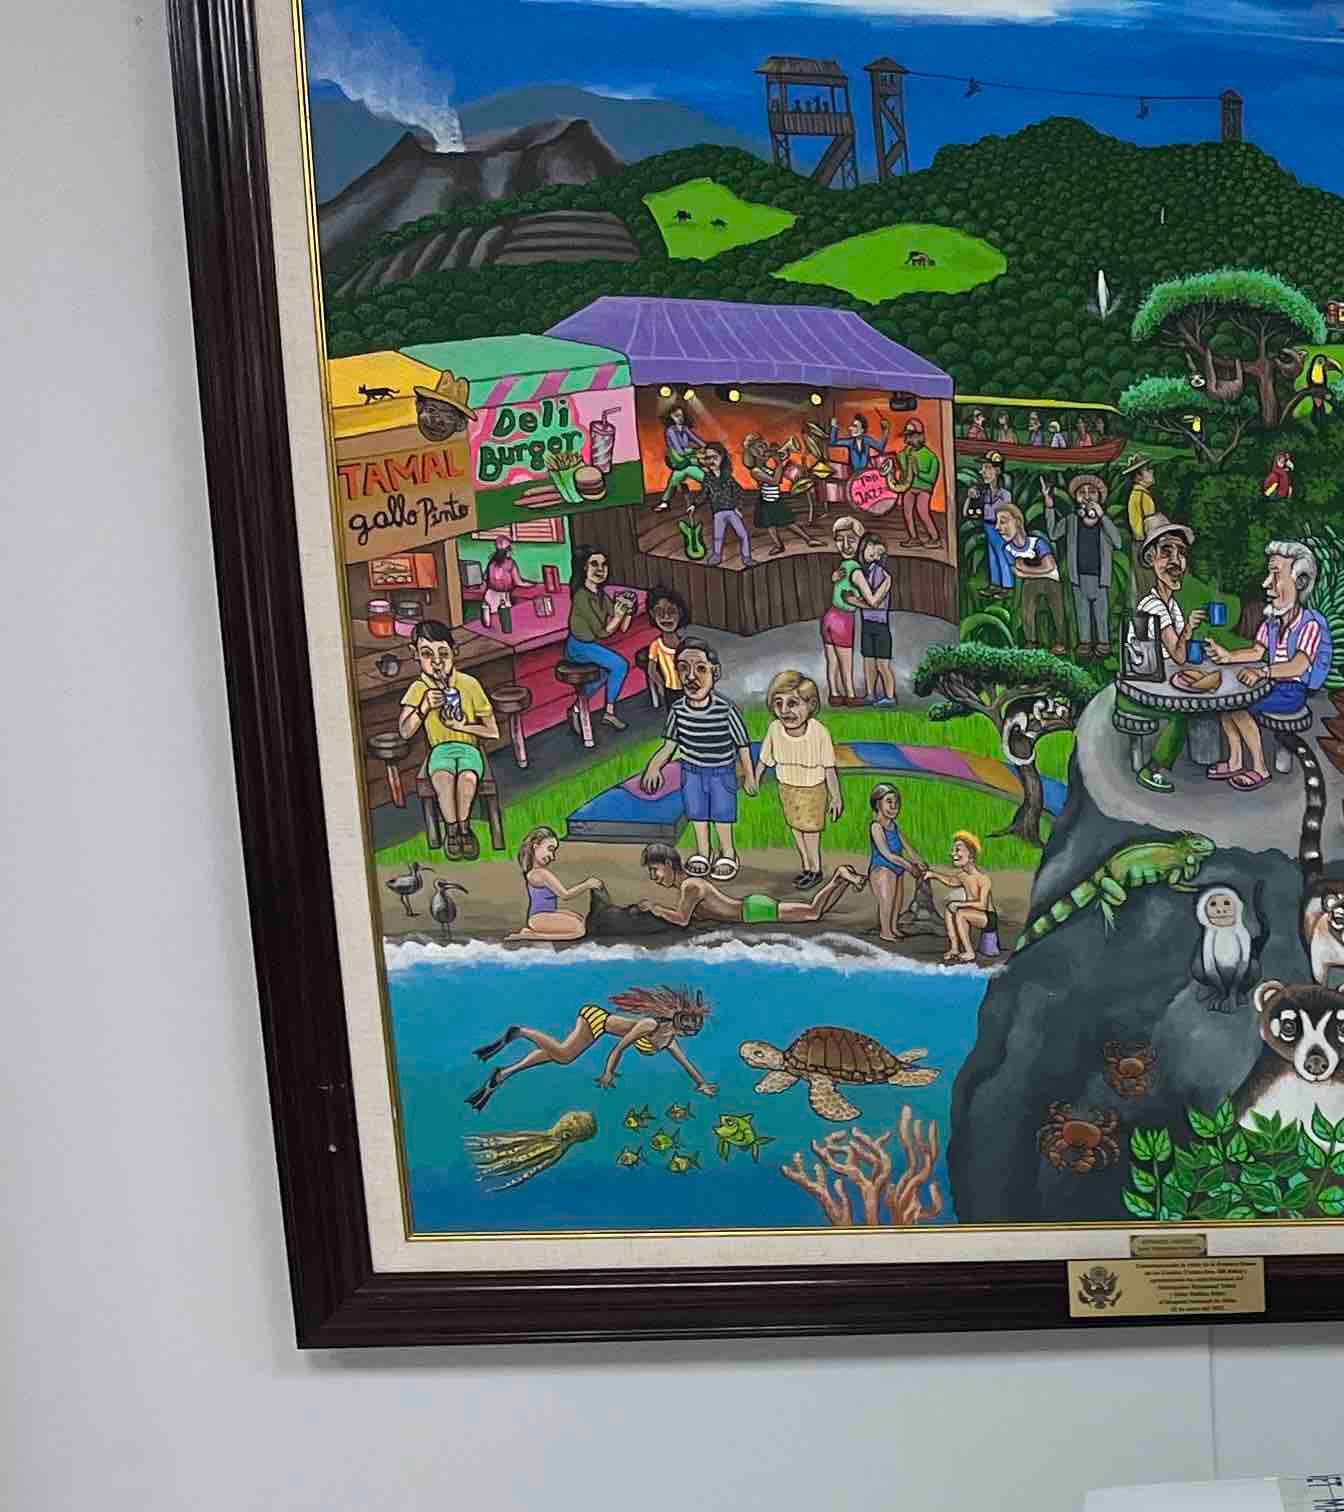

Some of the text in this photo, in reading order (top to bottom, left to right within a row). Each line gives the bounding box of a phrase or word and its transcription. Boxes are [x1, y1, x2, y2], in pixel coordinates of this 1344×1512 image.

[493, 398, 570, 439] Deli
[337, 449, 465, 500] TAMAL
[478, 430, 583, 482] Burger
[349, 494, 469, 546] gallo Pinto
